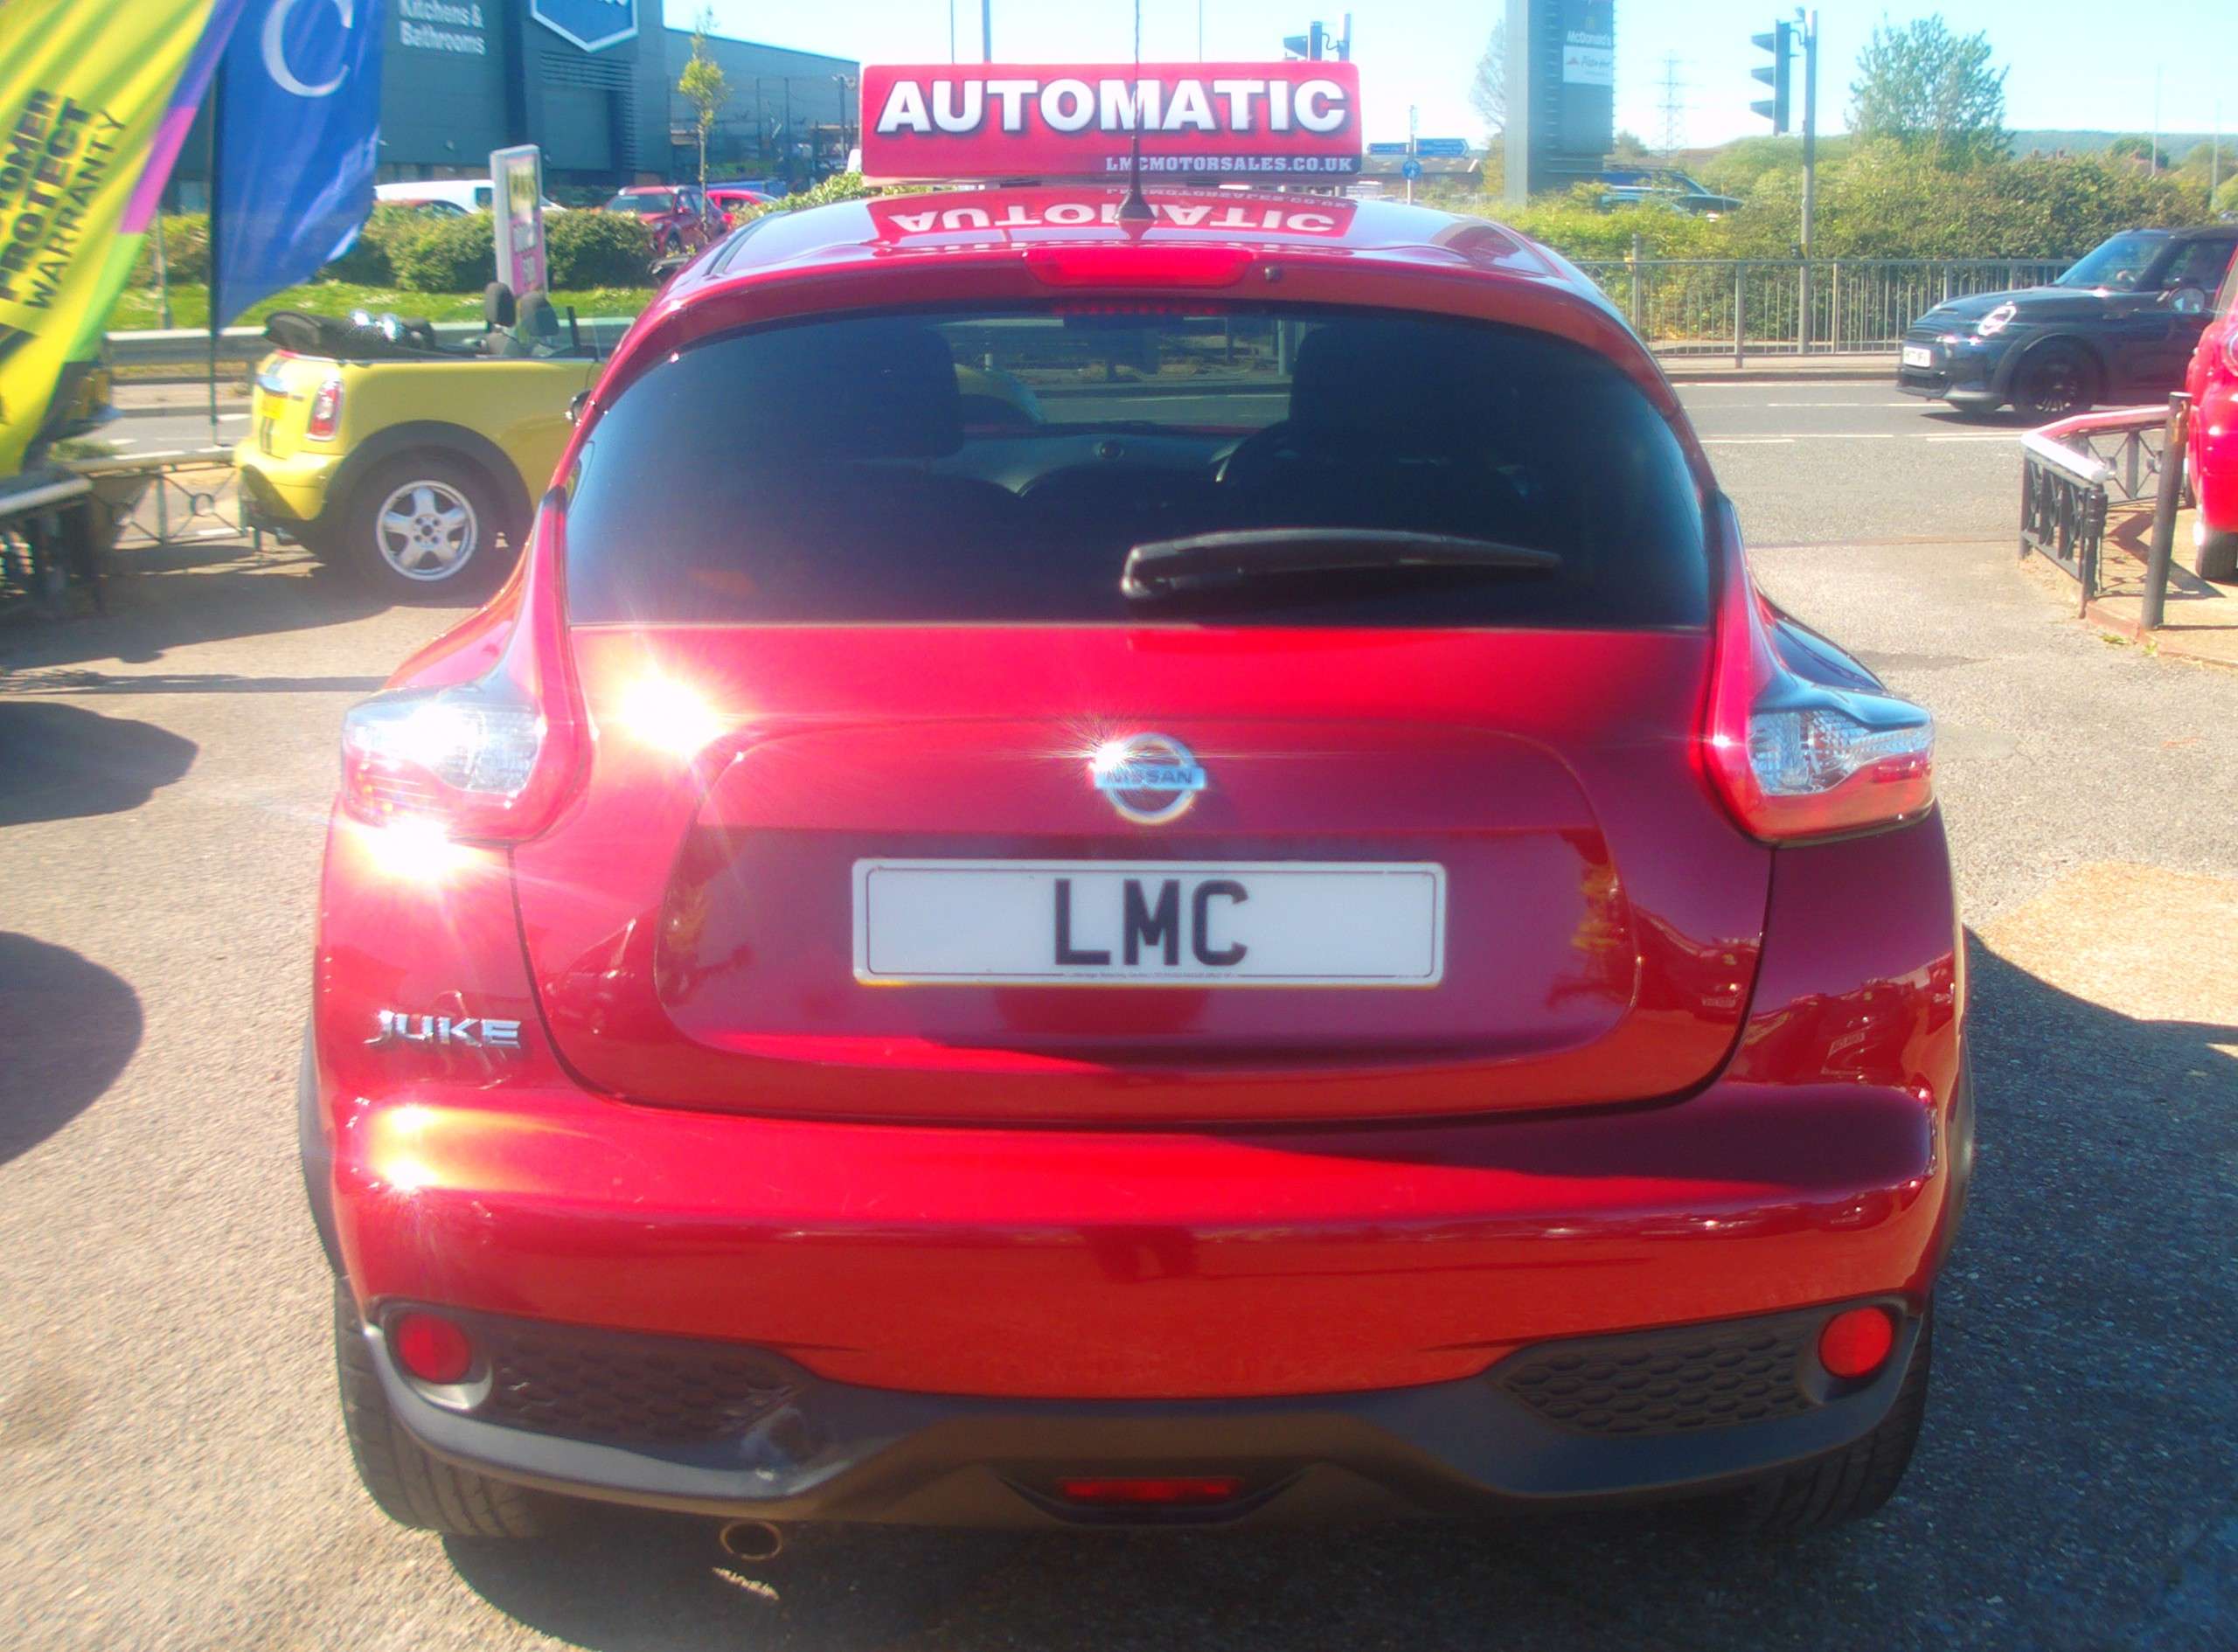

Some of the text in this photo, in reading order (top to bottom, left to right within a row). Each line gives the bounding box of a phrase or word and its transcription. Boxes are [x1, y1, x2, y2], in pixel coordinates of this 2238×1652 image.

[400, 20, 486, 54] Bathrooms
[877, 79, 1347, 132] AUTOMATIC
[24, 109, 126, 309] WARRANTY
[1106, 768, 1193, 784] NISSAN
[1054, 878, 1249, 968] LMC
[364, 1010, 521, 1049] JUKE
